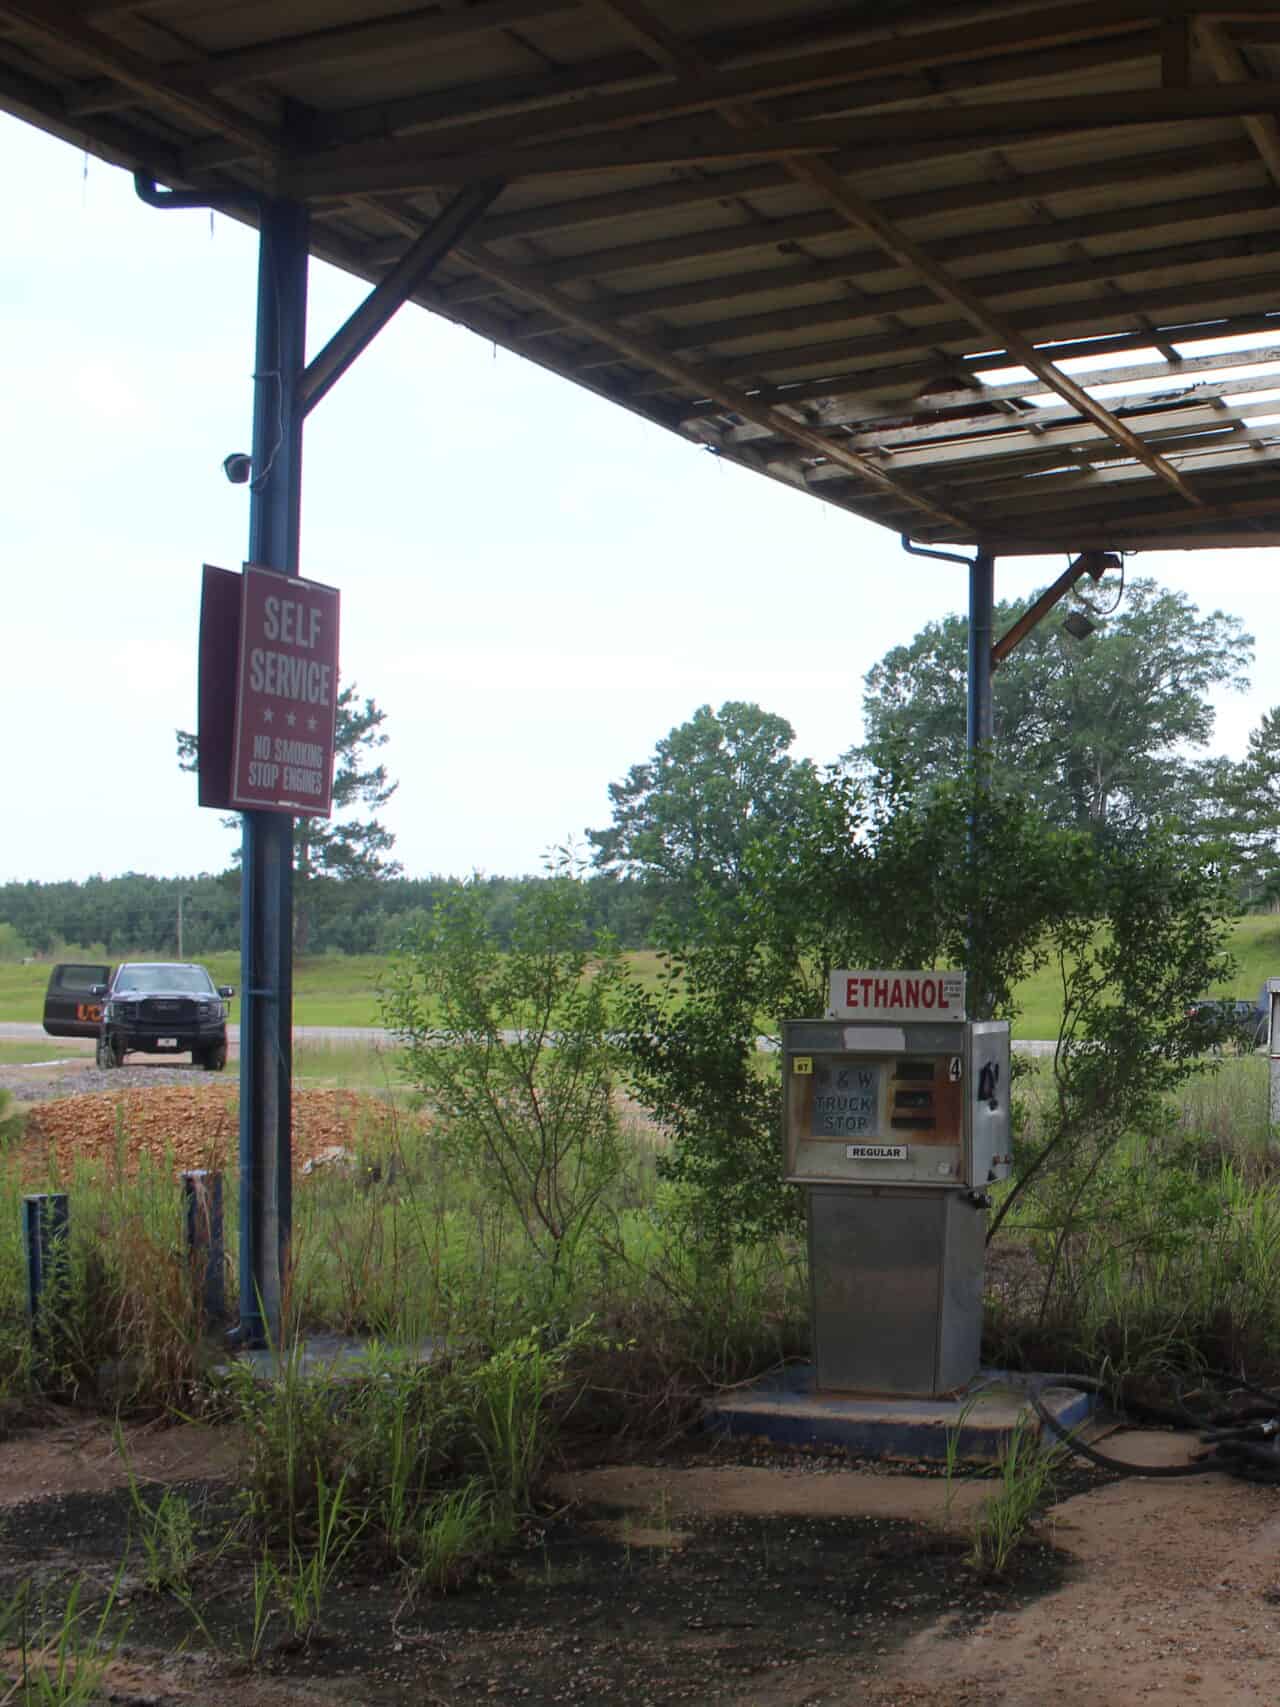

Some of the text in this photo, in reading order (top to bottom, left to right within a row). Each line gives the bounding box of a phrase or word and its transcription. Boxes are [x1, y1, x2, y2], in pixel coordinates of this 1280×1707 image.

[263, 595, 322, 649] SELF
[250, 647, 331, 706] SERVICE
[254, 735, 323, 768] NO SMOKING
[248, 760, 323, 795] STOP ENGINES
[845, 978, 950, 1009] ETHANOL
[951, 1060, 960, 1080] 4
[815, 1096, 872, 1113] TRUCK
[824, 1115, 868, 1130] STOP
[852, 1147, 900, 1157] REGULAR
